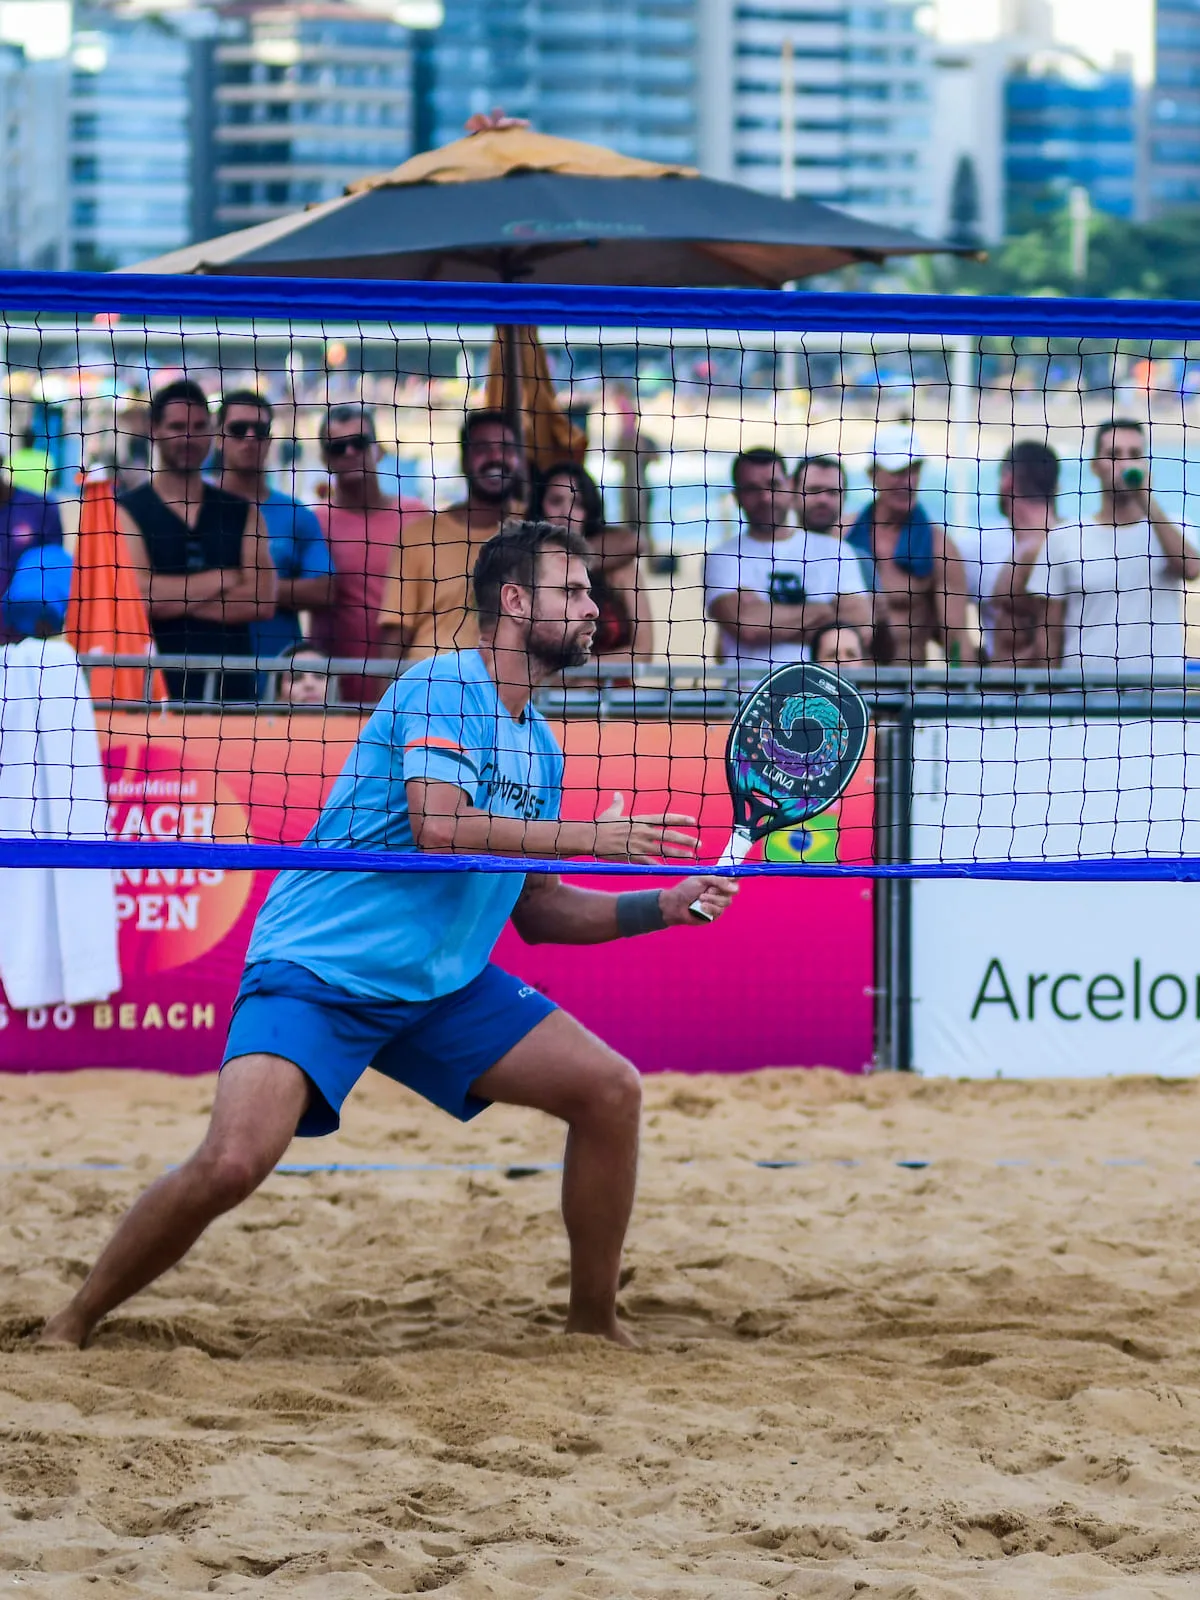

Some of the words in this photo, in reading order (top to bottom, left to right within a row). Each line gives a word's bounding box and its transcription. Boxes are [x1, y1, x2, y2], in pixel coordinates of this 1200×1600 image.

[762, 763, 794, 790] LUNA
[115, 895, 200, 930] PEN
[93, 1003, 215, 1029] BEACH
